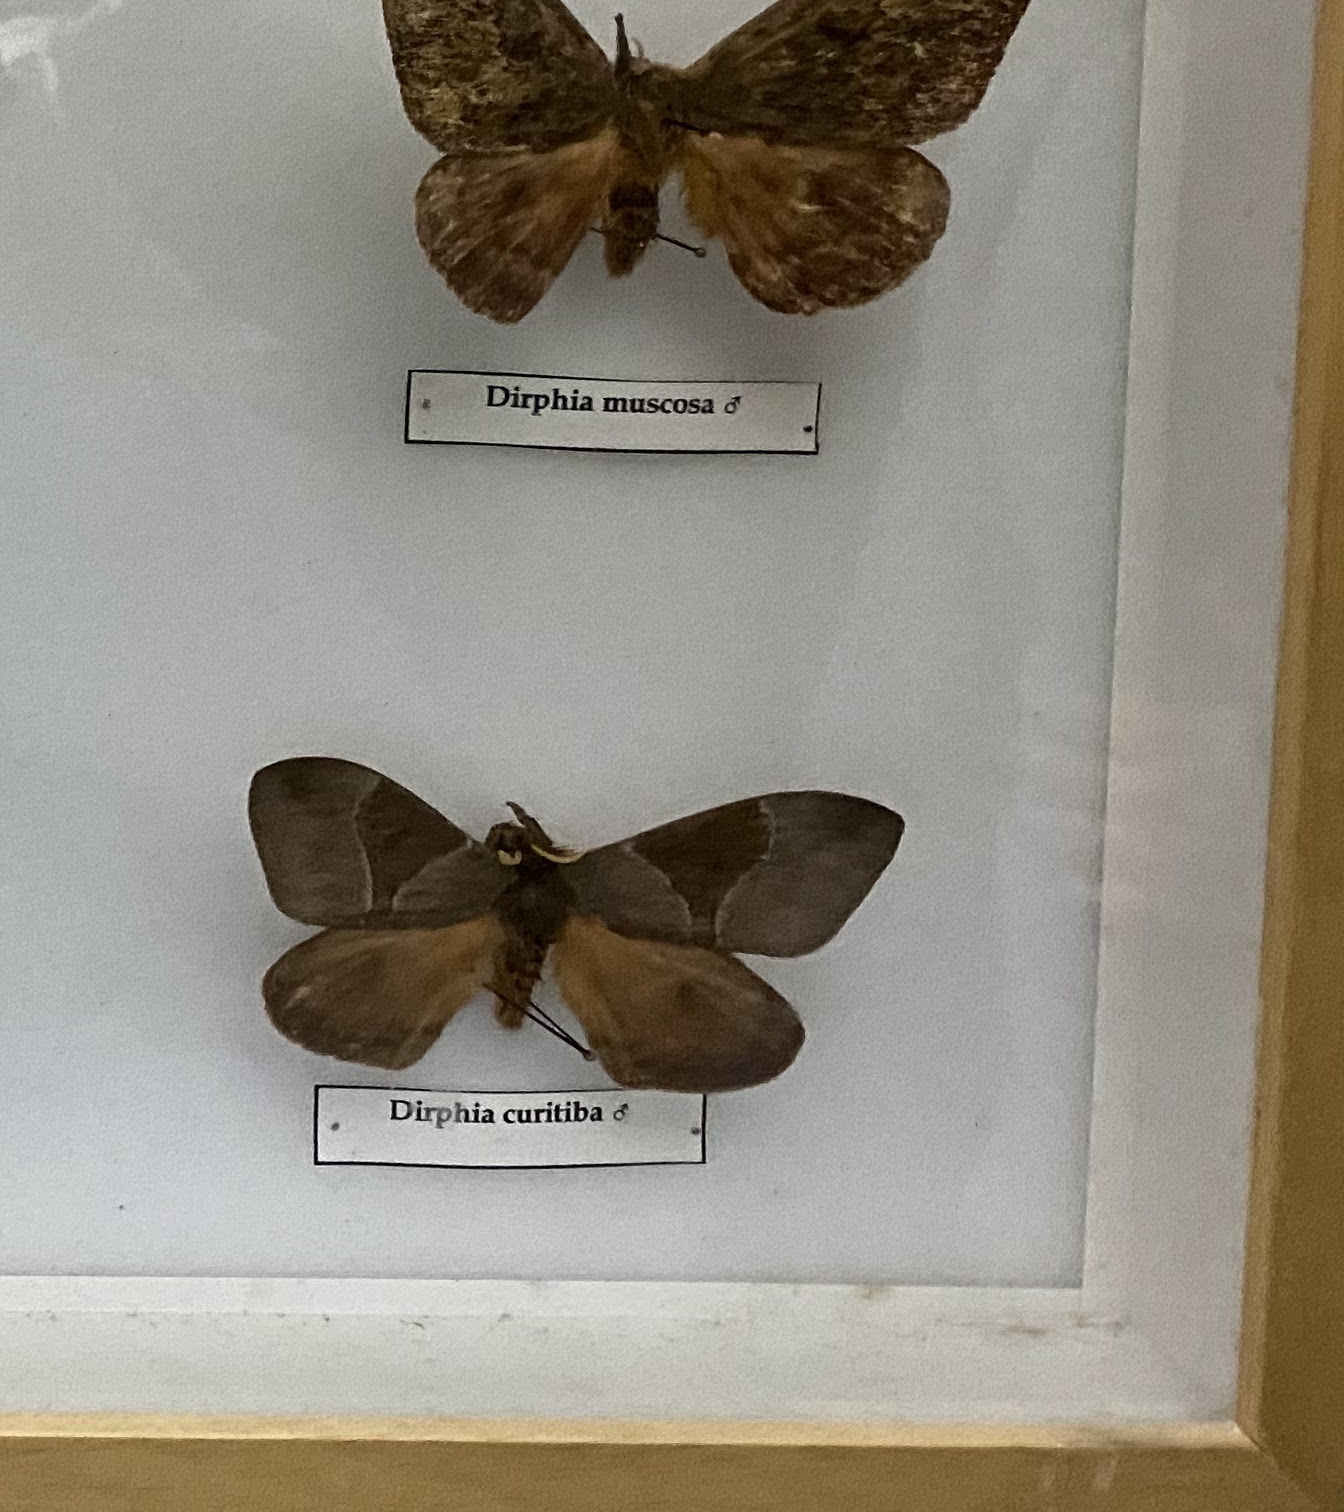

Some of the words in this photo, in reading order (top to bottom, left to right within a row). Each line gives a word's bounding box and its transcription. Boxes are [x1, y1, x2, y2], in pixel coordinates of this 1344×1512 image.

[486, 384, 593, 416] Dirphia
[602, 395, 715, 415] muscosa
[390, 1099, 495, 1129] Dirphia
[503, 1101, 604, 1123] curitiba
